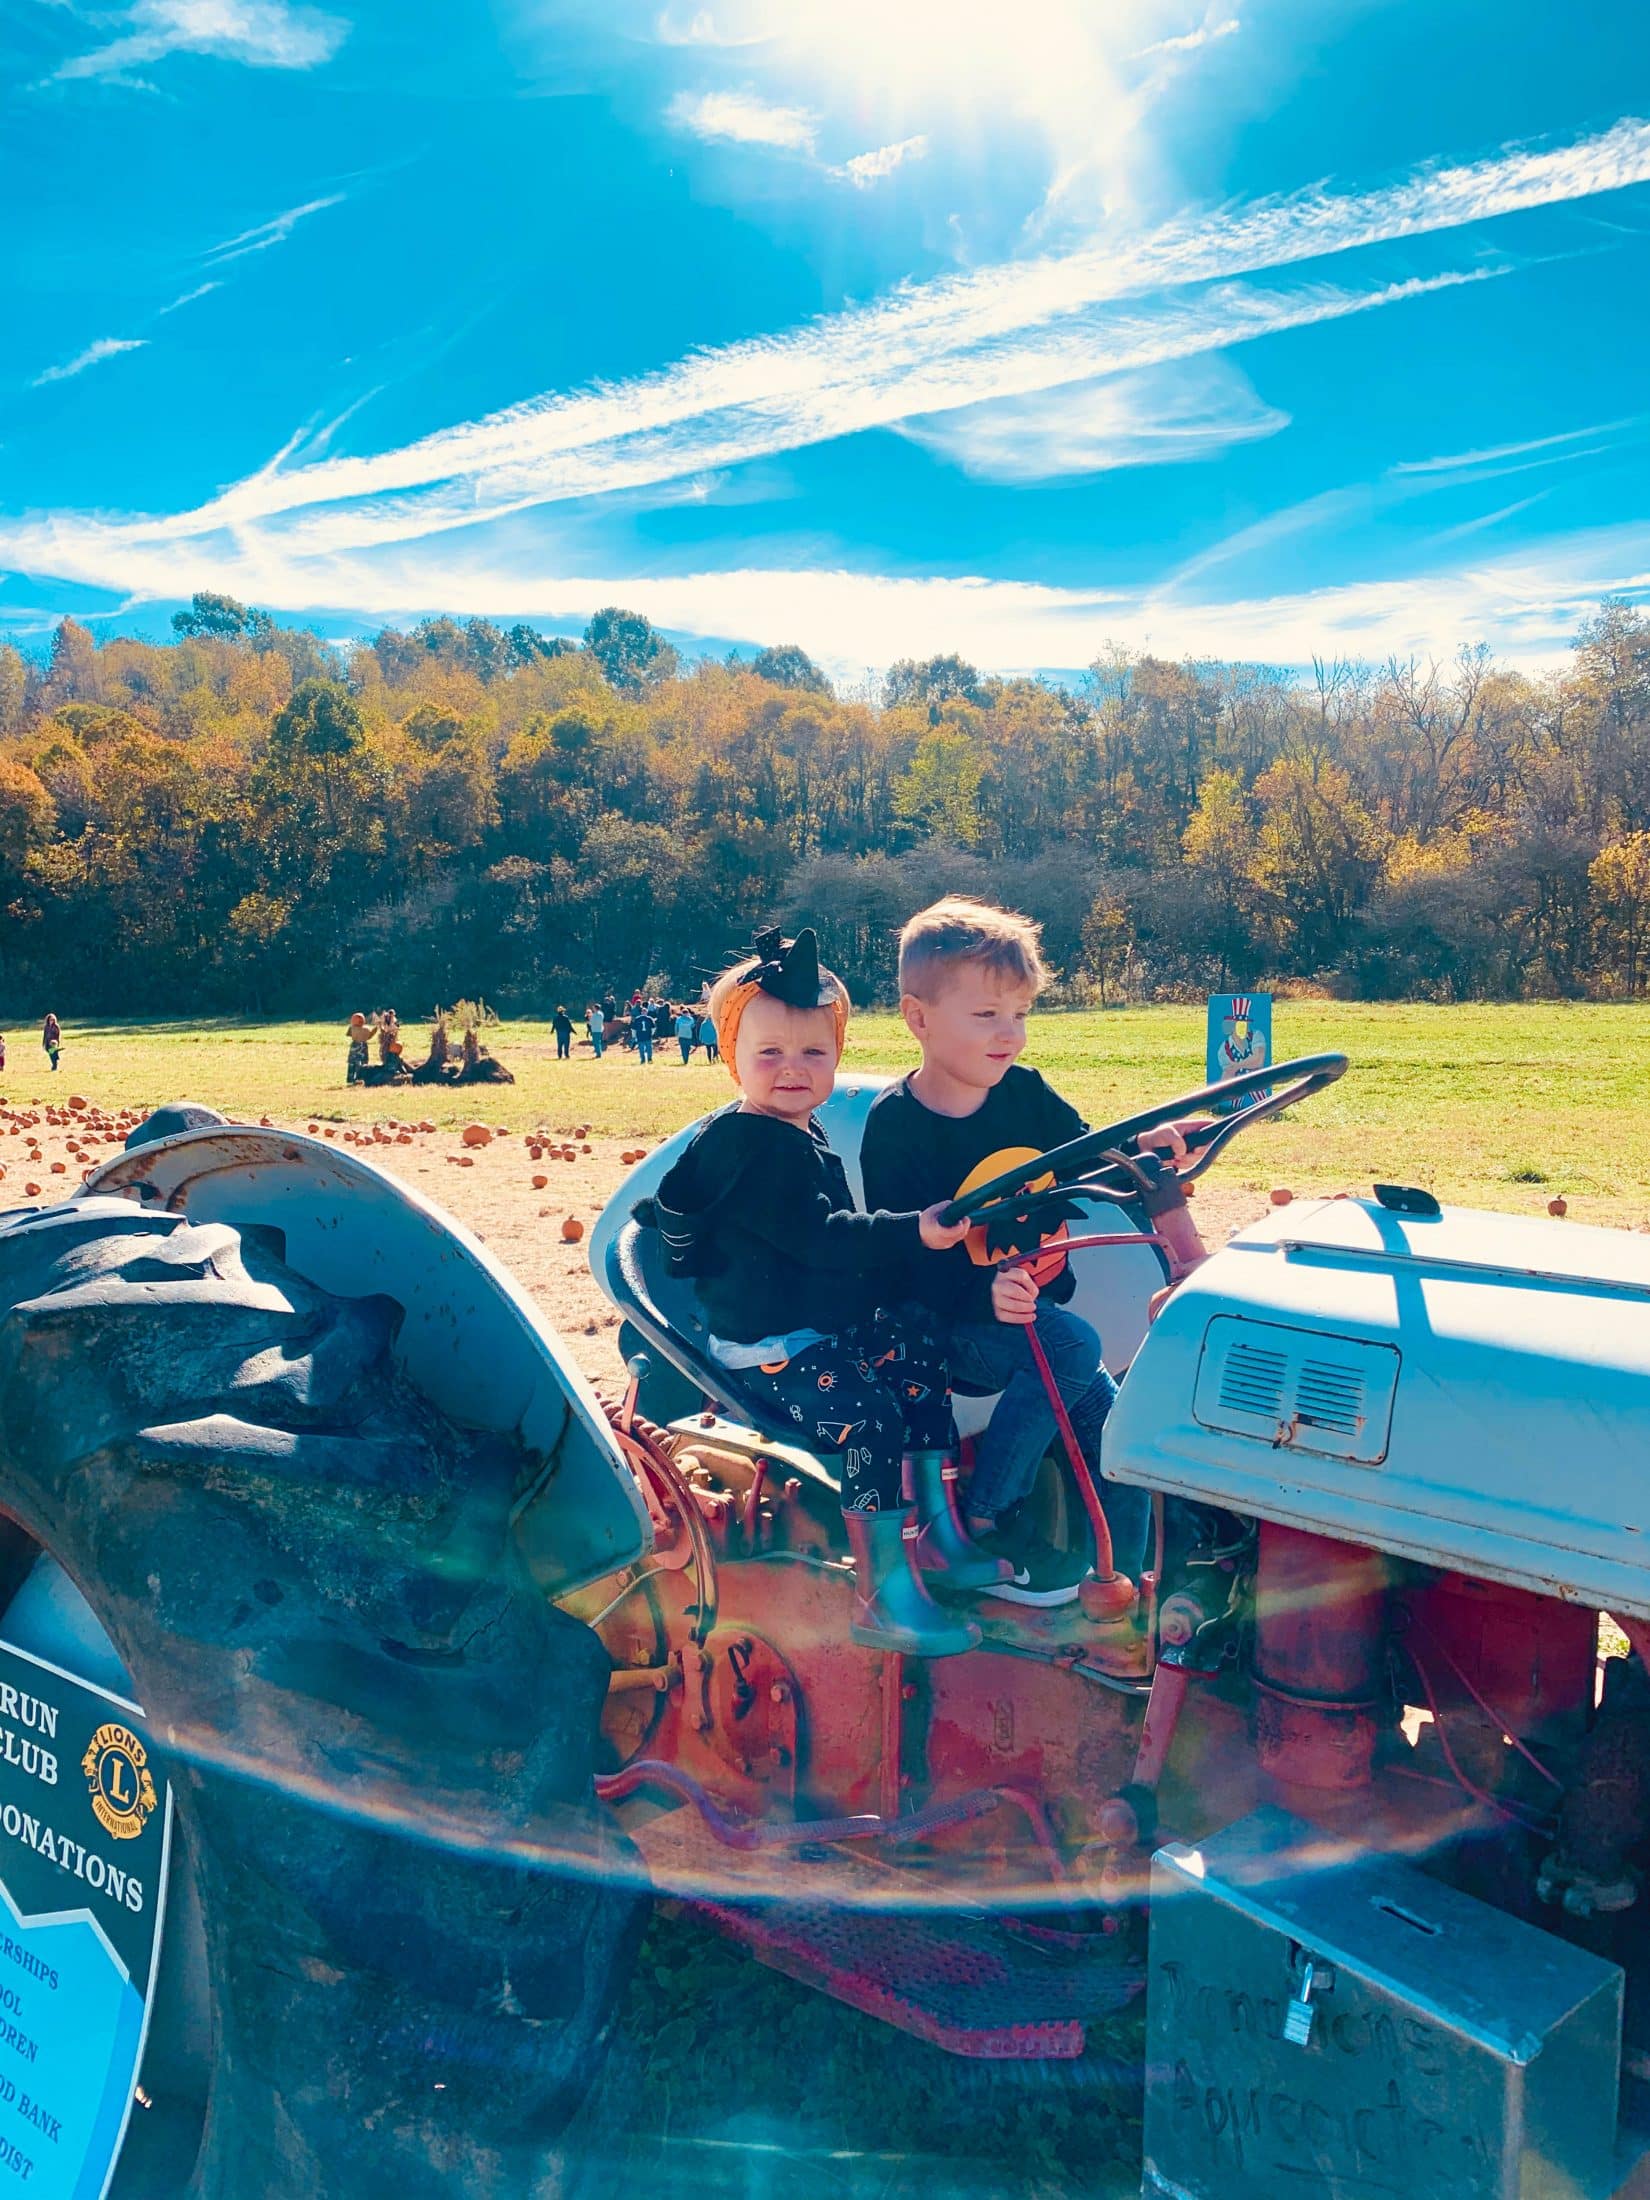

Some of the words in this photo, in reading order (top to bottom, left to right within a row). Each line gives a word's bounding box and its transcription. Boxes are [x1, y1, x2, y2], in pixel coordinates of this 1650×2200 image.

[0, 1682, 59, 1738] RUN
[0, 1727, 58, 1785] LUB
[99, 1726, 145, 1763] LIONS
[109, 1757, 130, 1804] L
[0, 1803, 144, 1913] ONATIONS
[18, 2093, 62, 2145] BANK
[0, 2137, 33, 2181] DIST
